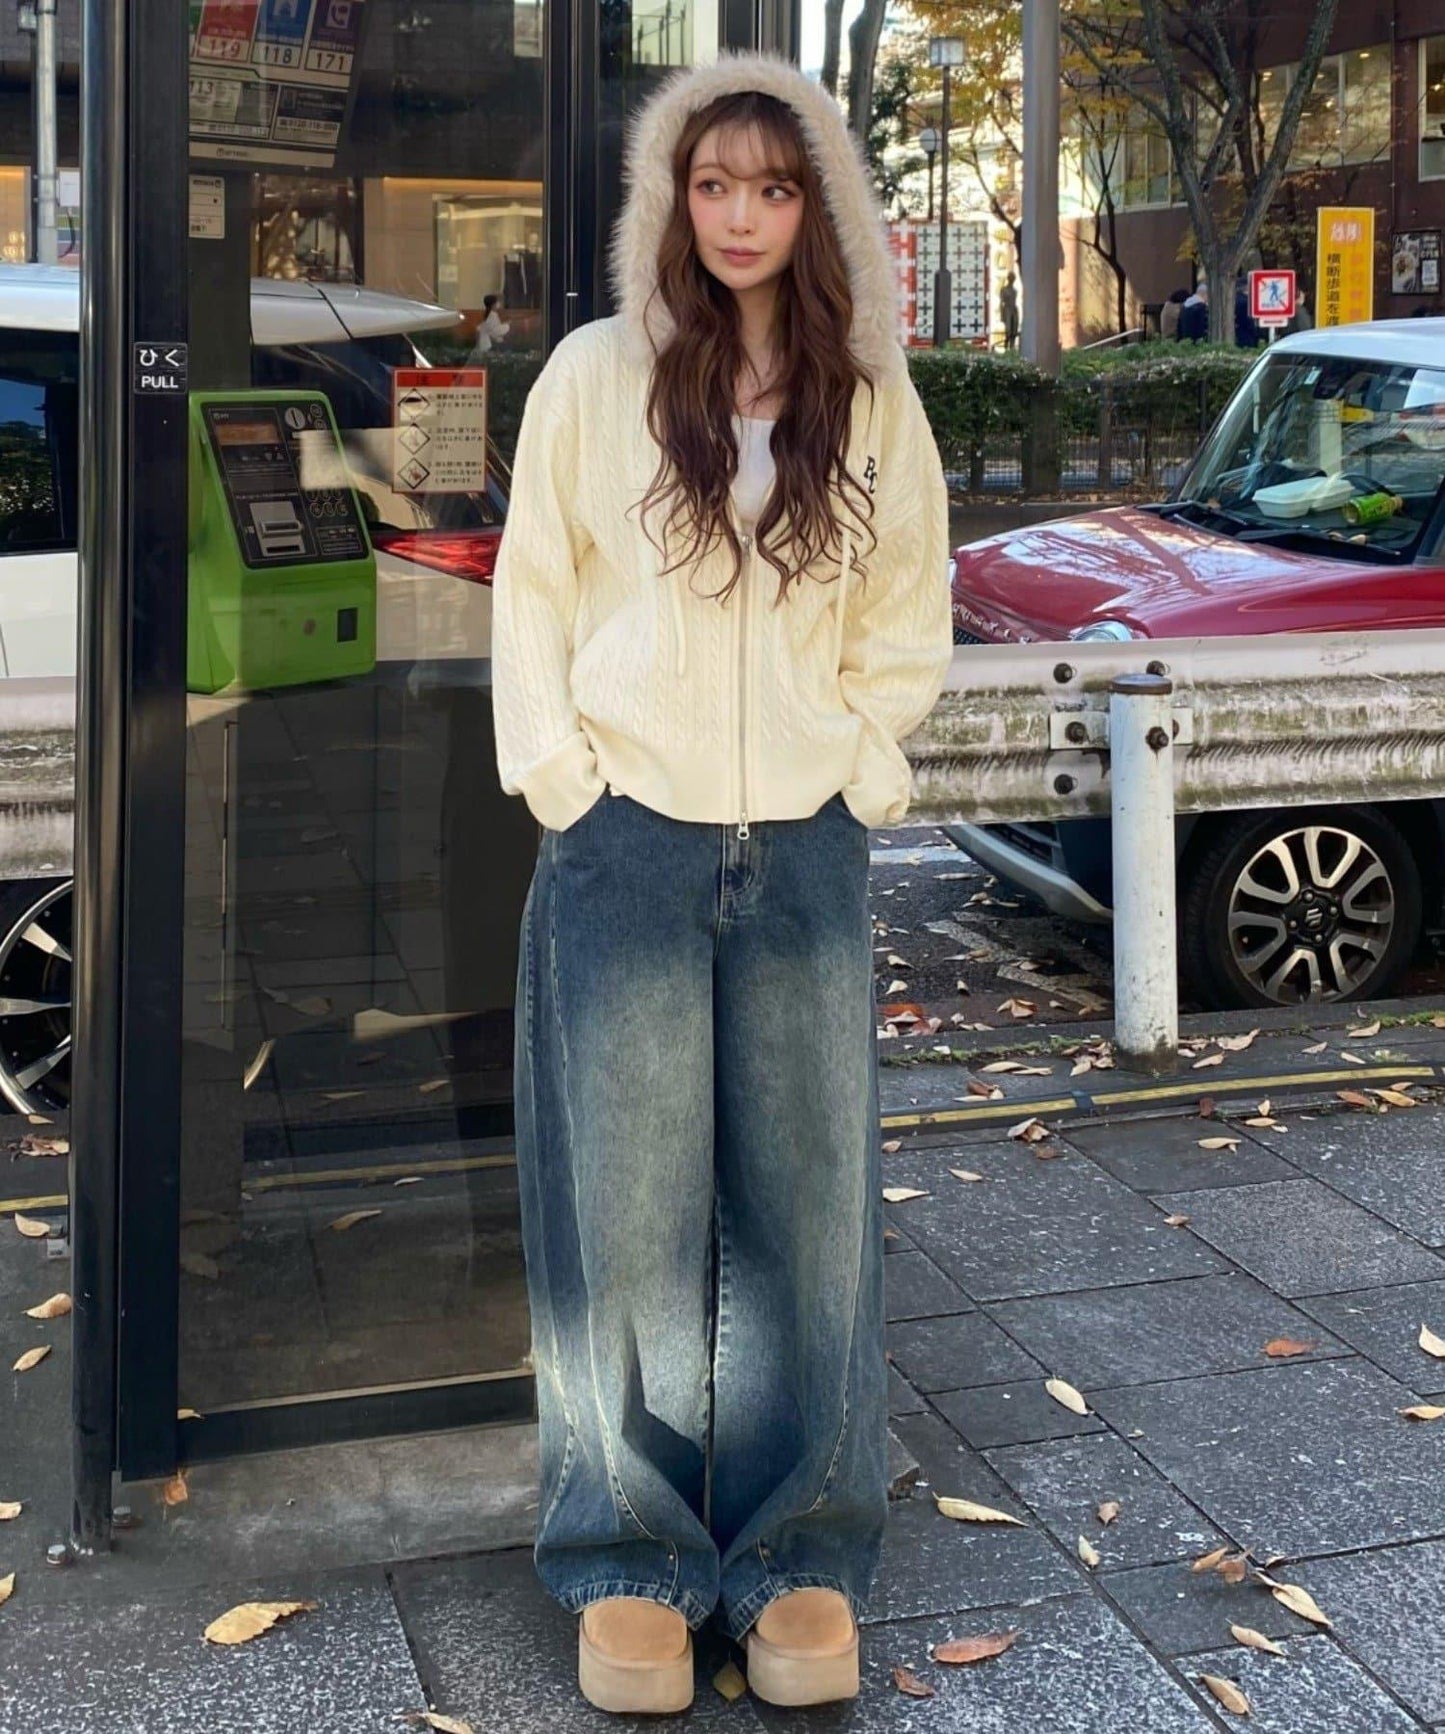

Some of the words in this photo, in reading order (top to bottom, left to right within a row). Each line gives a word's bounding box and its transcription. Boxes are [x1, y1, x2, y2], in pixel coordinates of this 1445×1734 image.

[209, 39, 241, 58] 119
[264, 46, 293, 64] 118
[316, 53, 345, 71] 171
[139, 348, 180, 367] ひく
[141, 375, 179, 389] PULL
